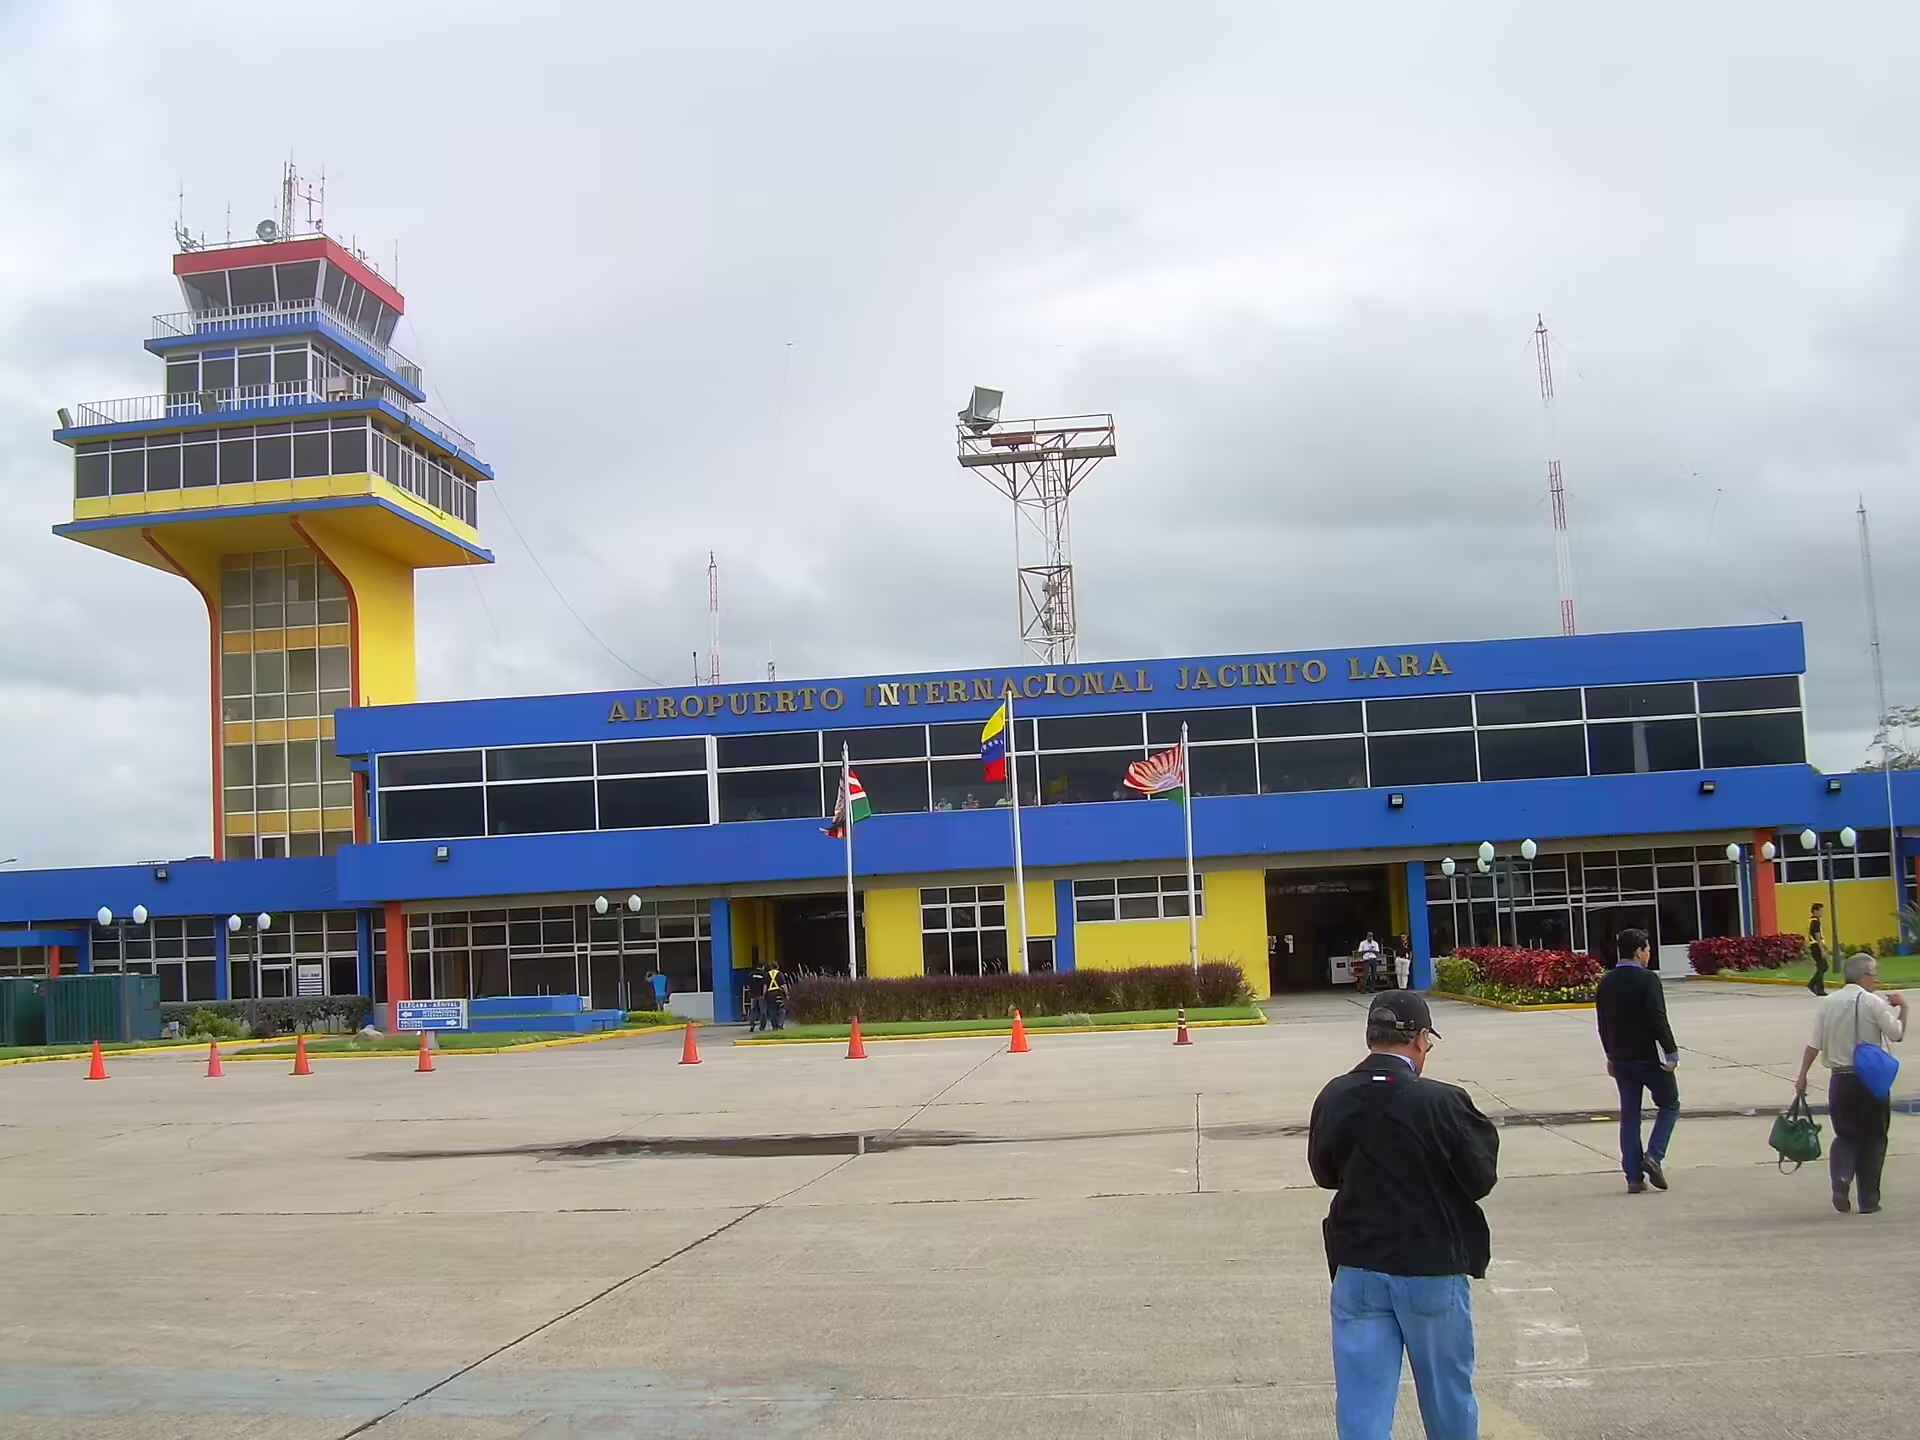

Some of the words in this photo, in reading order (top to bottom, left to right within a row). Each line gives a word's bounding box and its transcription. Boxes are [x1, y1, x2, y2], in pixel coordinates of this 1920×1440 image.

[607, 687, 845, 723] AEROPUERTO
[864, 669, 1153, 707] INTERNACIONAL
[1175, 659, 1328, 690] JACINTO
[1348, 651, 1452, 680] LARA
